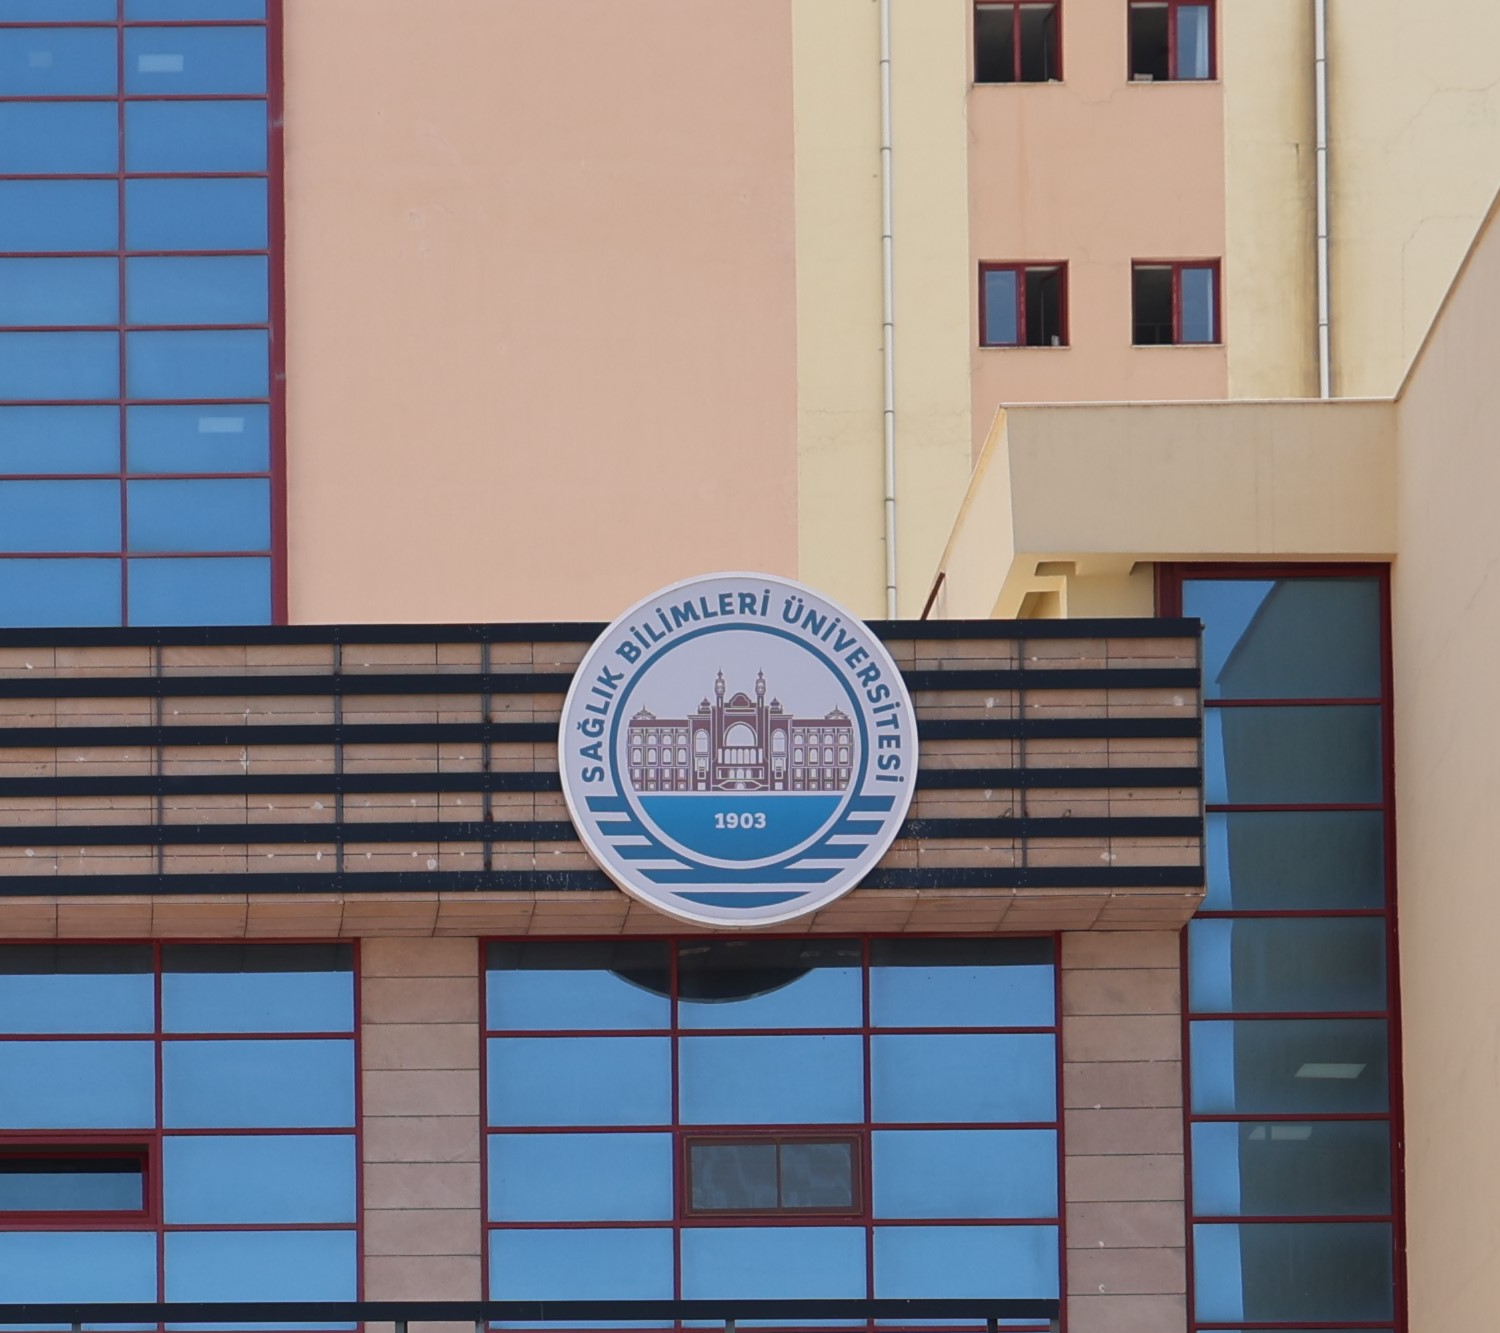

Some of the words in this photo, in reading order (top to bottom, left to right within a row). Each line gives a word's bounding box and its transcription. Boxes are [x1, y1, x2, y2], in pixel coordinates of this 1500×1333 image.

[576, 664, 625, 784] SAĞLIK
[615, 588, 771, 665] BİLİMLERİ
[781, 594, 906, 785] ÜNİVERSİTESİ
[714, 811, 767, 830] 1903
